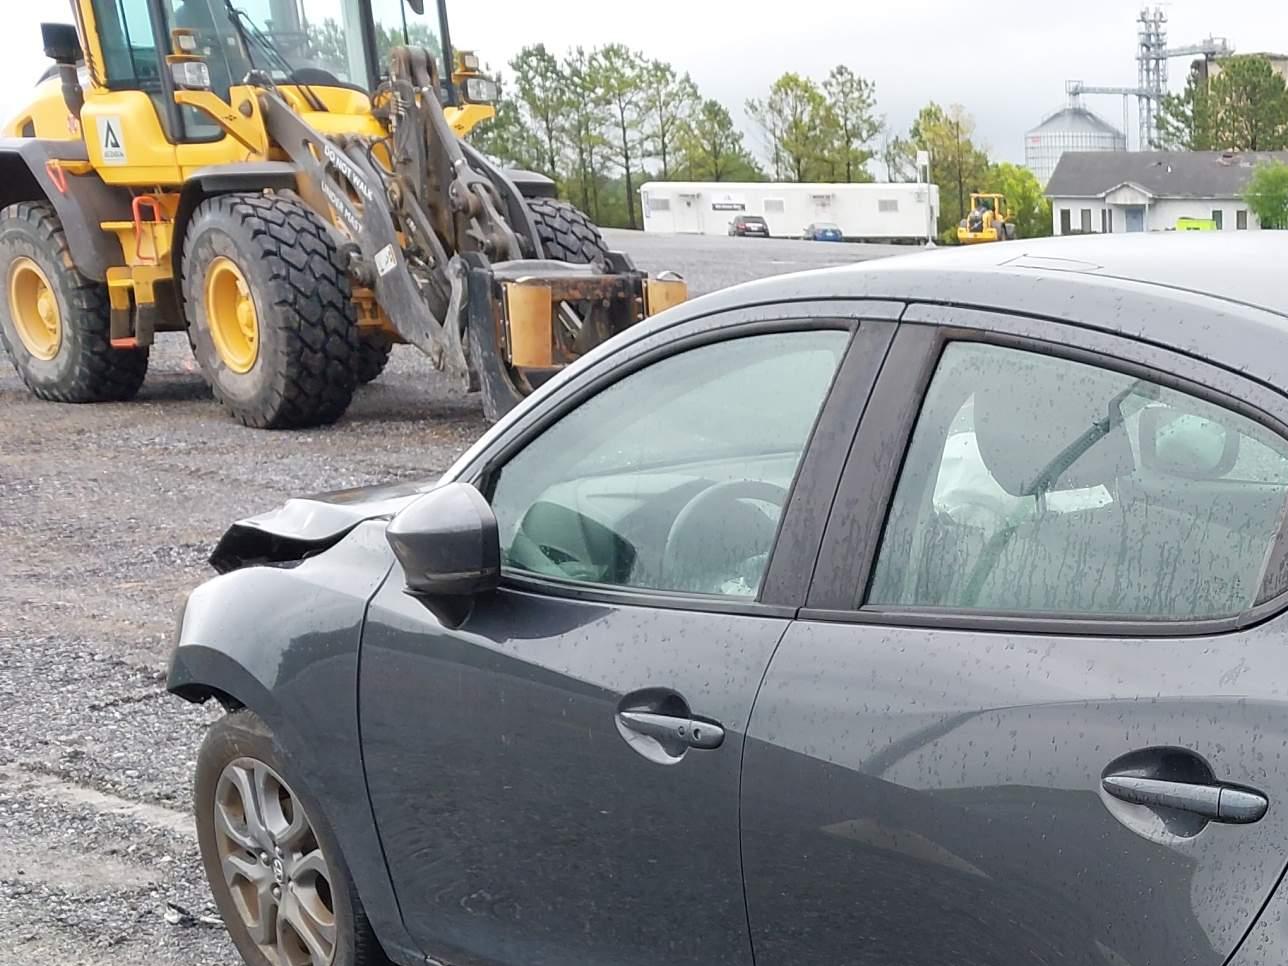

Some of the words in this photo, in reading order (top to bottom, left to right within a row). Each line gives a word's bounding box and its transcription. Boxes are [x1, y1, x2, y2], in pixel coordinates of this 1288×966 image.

[324, 144, 336, 162] DO
[335, 158, 353, 179] NOT
[352, 171, 374, 201] WALK
[321, 180, 345, 213] UNDER
